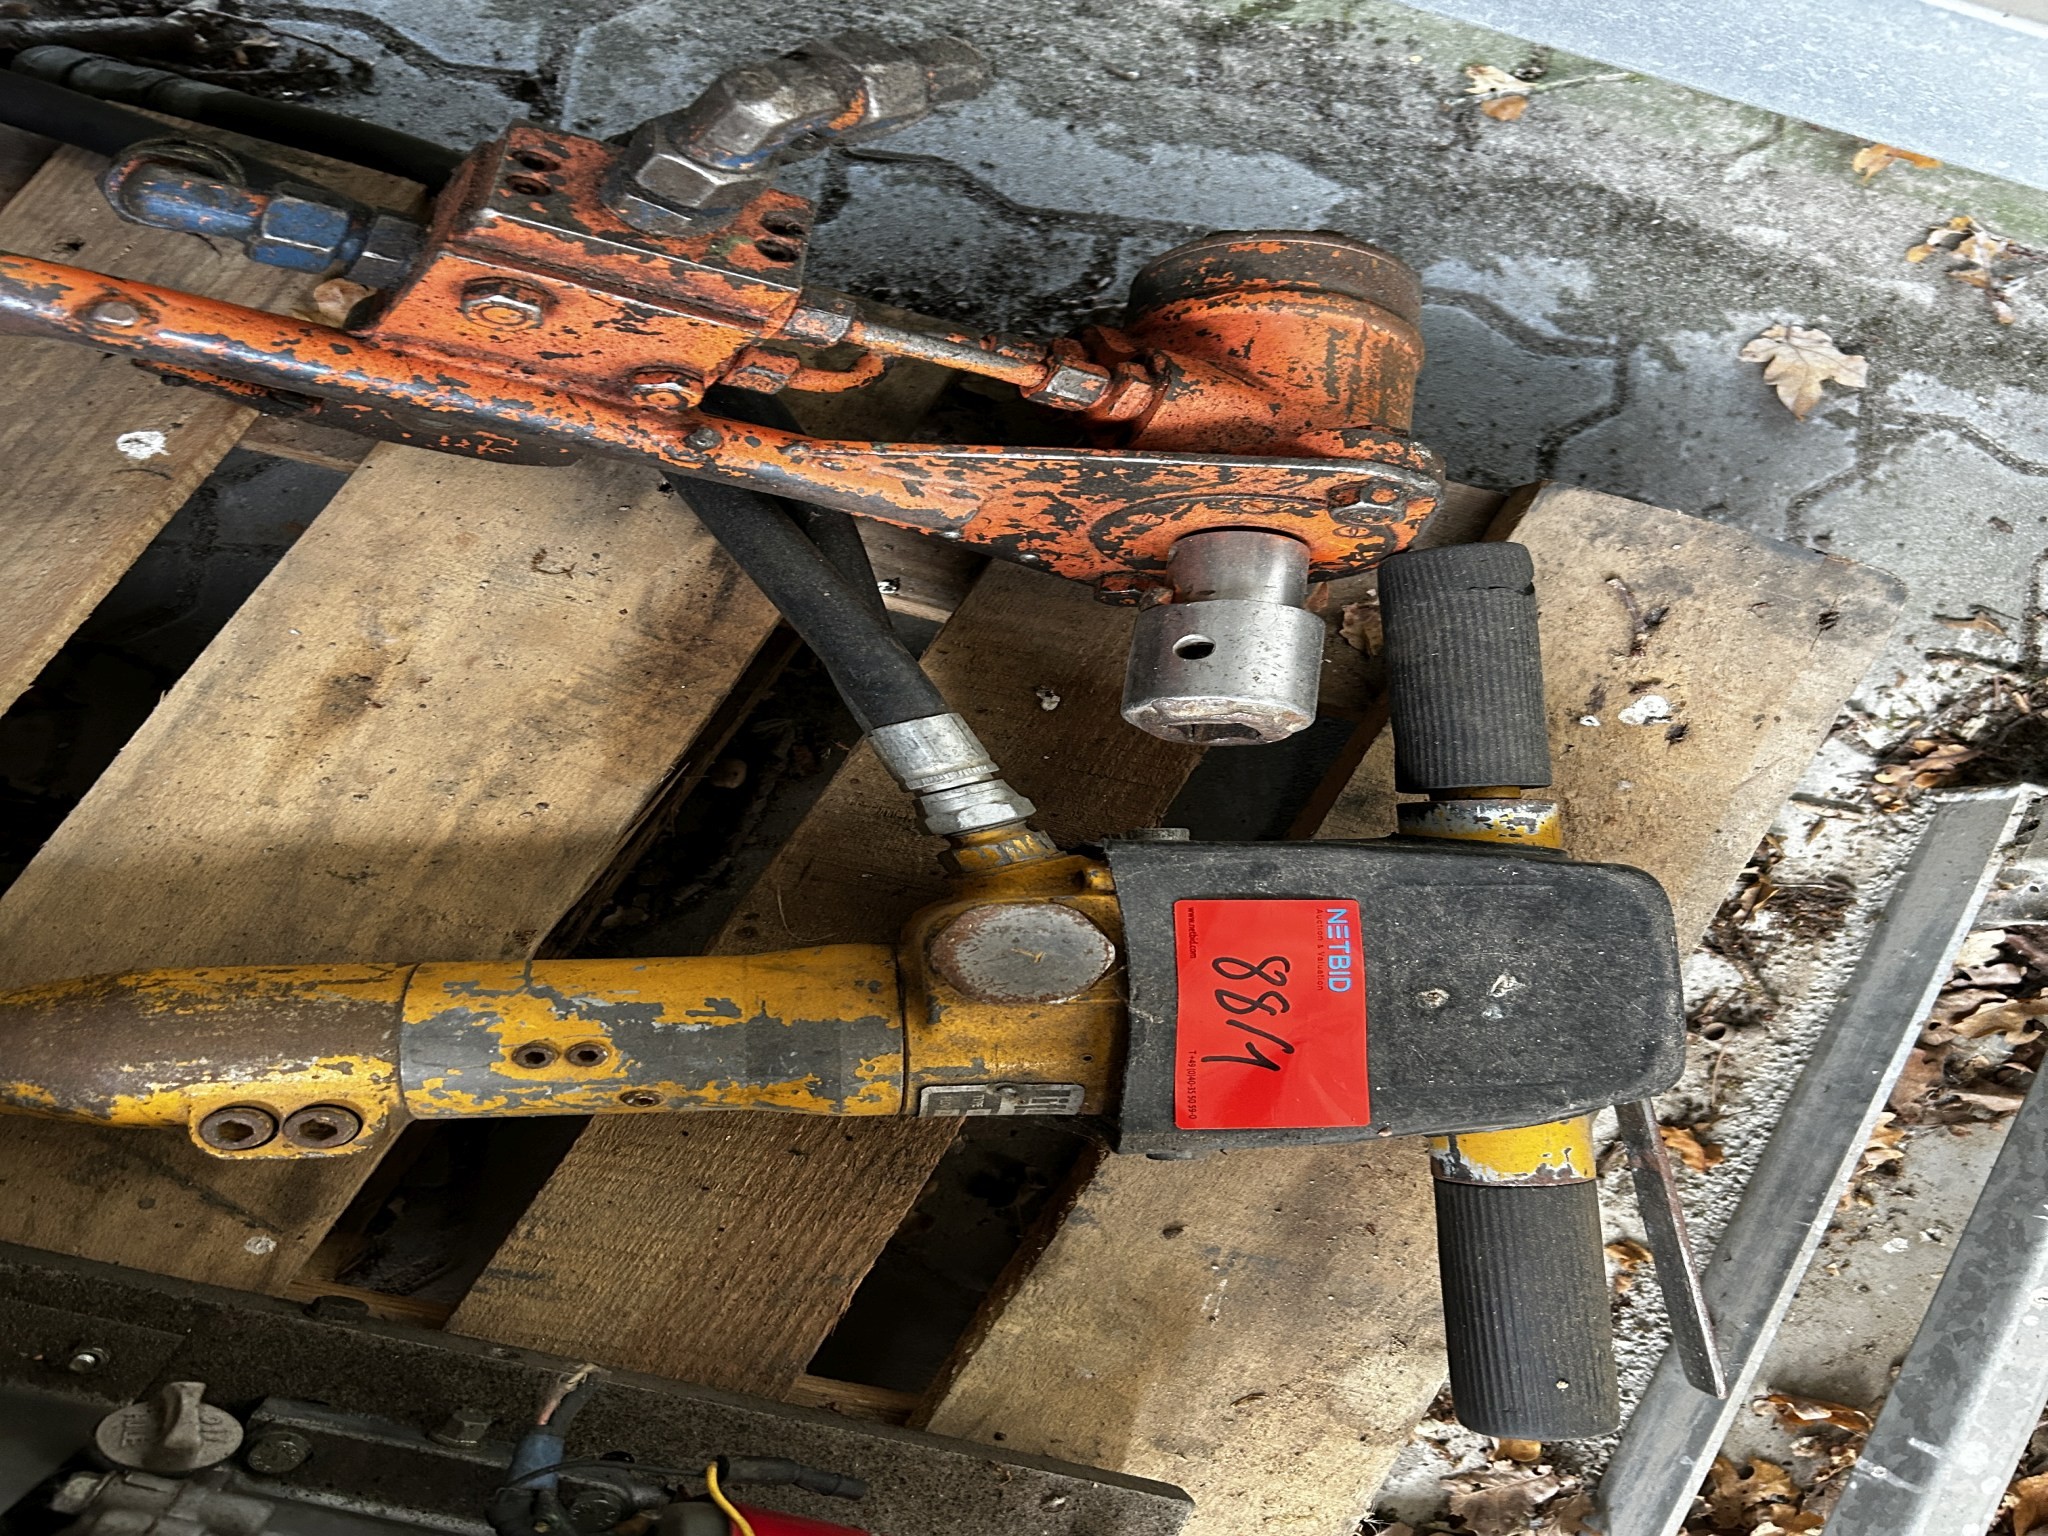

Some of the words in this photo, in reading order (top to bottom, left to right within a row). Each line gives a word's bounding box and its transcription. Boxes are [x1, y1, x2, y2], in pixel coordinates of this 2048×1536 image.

[1187, 906, 1199, 959] www.netbid.com
[1316, 908, 1325, 941] Auction
[1316, 951, 1326, 991] Valuation
[1326, 908, 1353, 993] NETBID
[1201, 956, 1295, 1072] 88/1
[1187, 1055, 1197, 1068] +49
